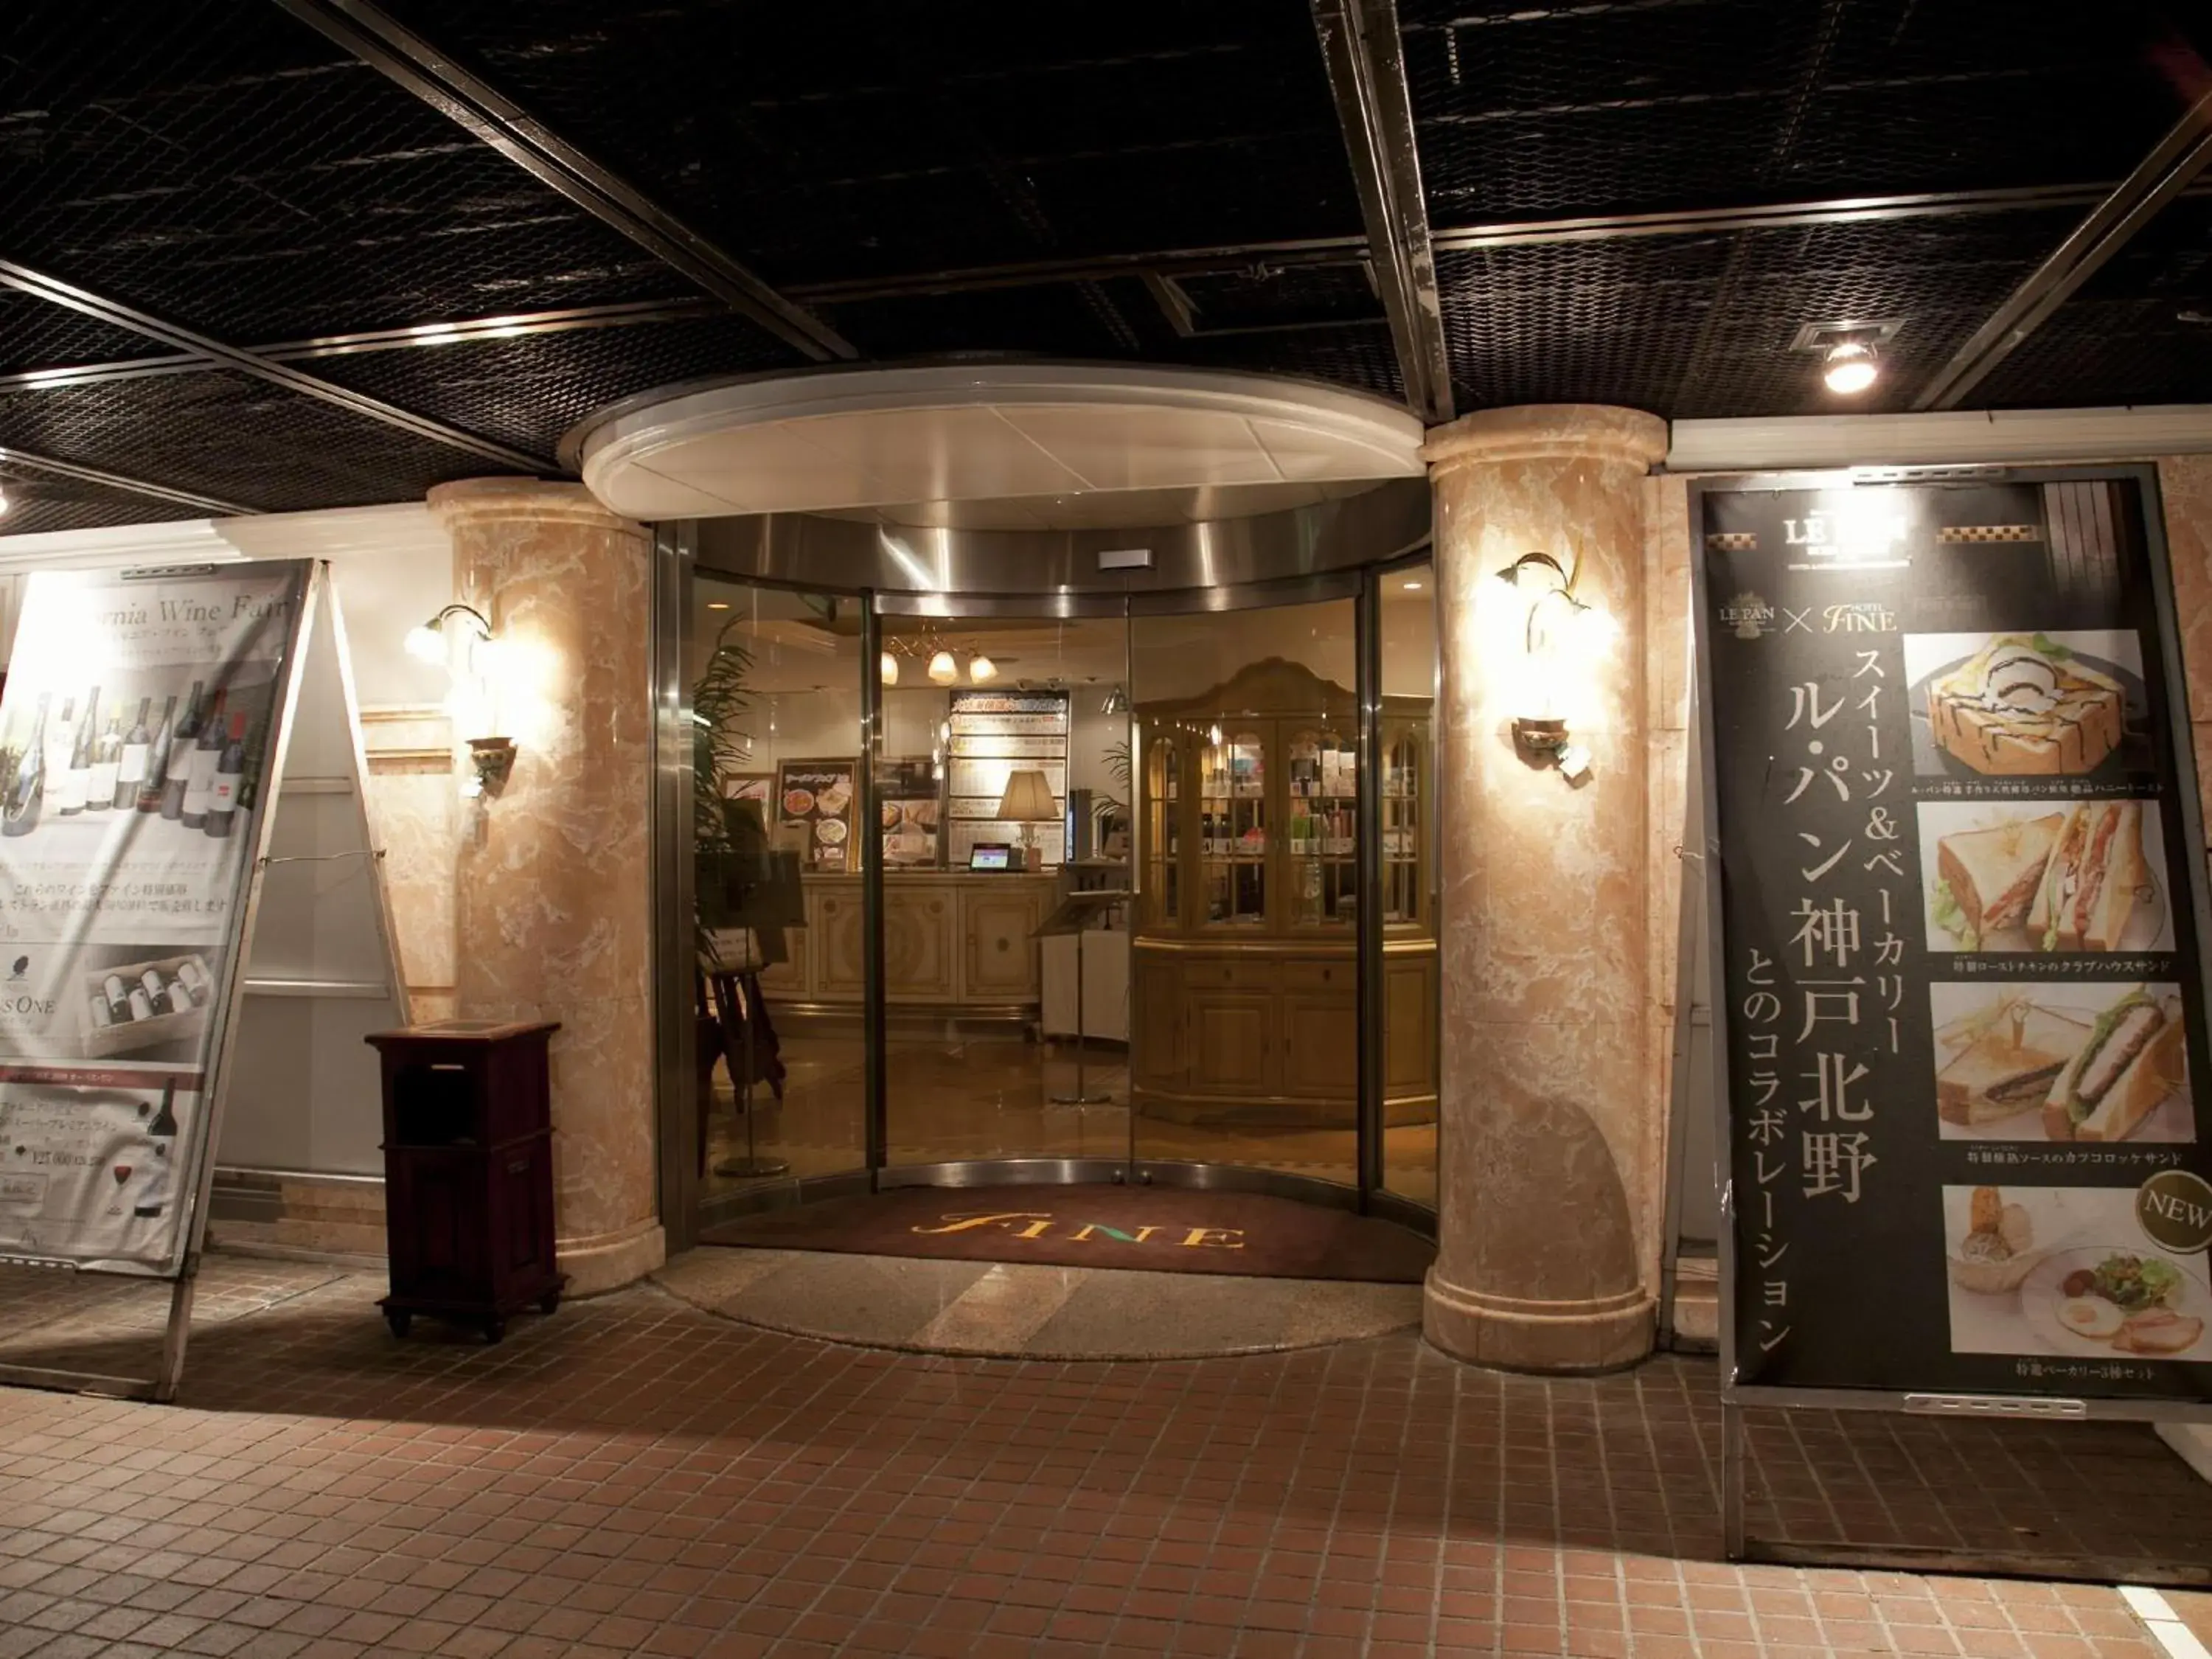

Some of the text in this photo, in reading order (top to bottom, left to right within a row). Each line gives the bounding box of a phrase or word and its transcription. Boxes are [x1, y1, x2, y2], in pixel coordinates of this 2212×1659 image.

[159, 599, 221, 622] Wine
[230, 594, 290, 620] Fair
[1742, 606, 1775, 620] PAN
[1822, 602, 1898, 633] FINE
[1784, 681, 1879, 1204] ル・パン神戸北野
[1743, 949, 1793, 1352] とのコラボレーション
[2144, 1189, 2212, 1230] NEW
[911, 1212, 1245, 1249] FINE
